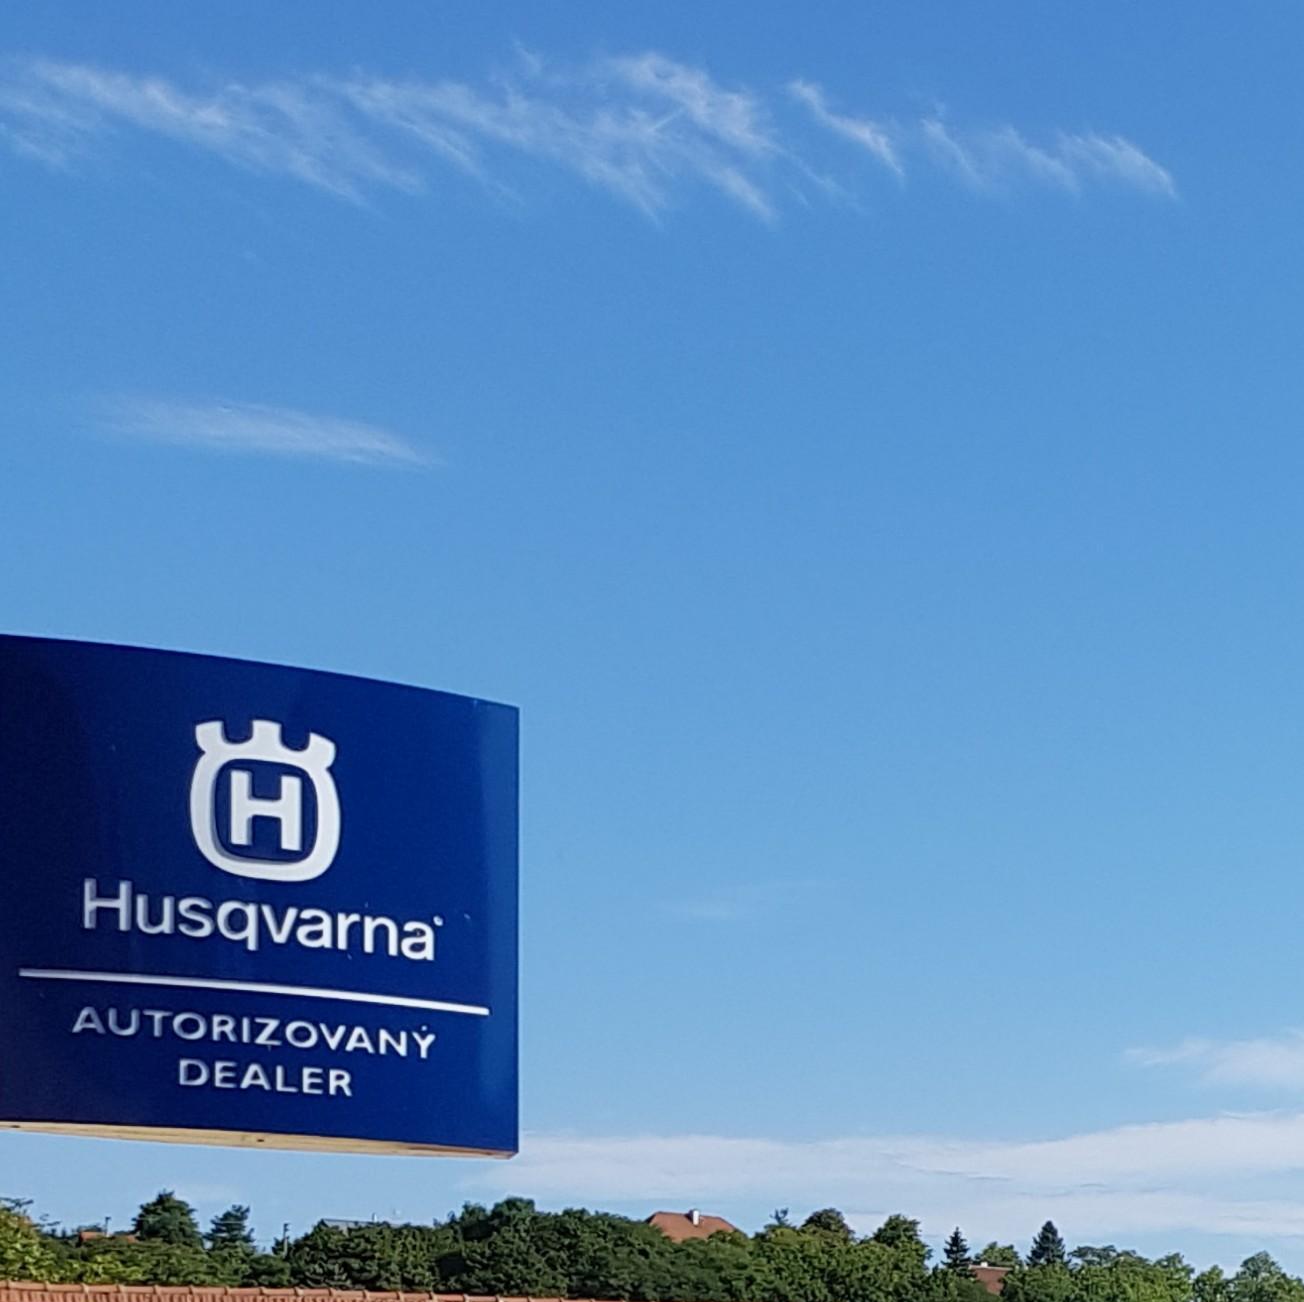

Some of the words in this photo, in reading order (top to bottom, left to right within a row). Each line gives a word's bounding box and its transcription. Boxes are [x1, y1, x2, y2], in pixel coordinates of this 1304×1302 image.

[83, 877, 435, 961] Husqvarna
[72, 1005, 437, 1059] AUTORIZOVANÝ
[178, 1058, 353, 1097] DEALER
